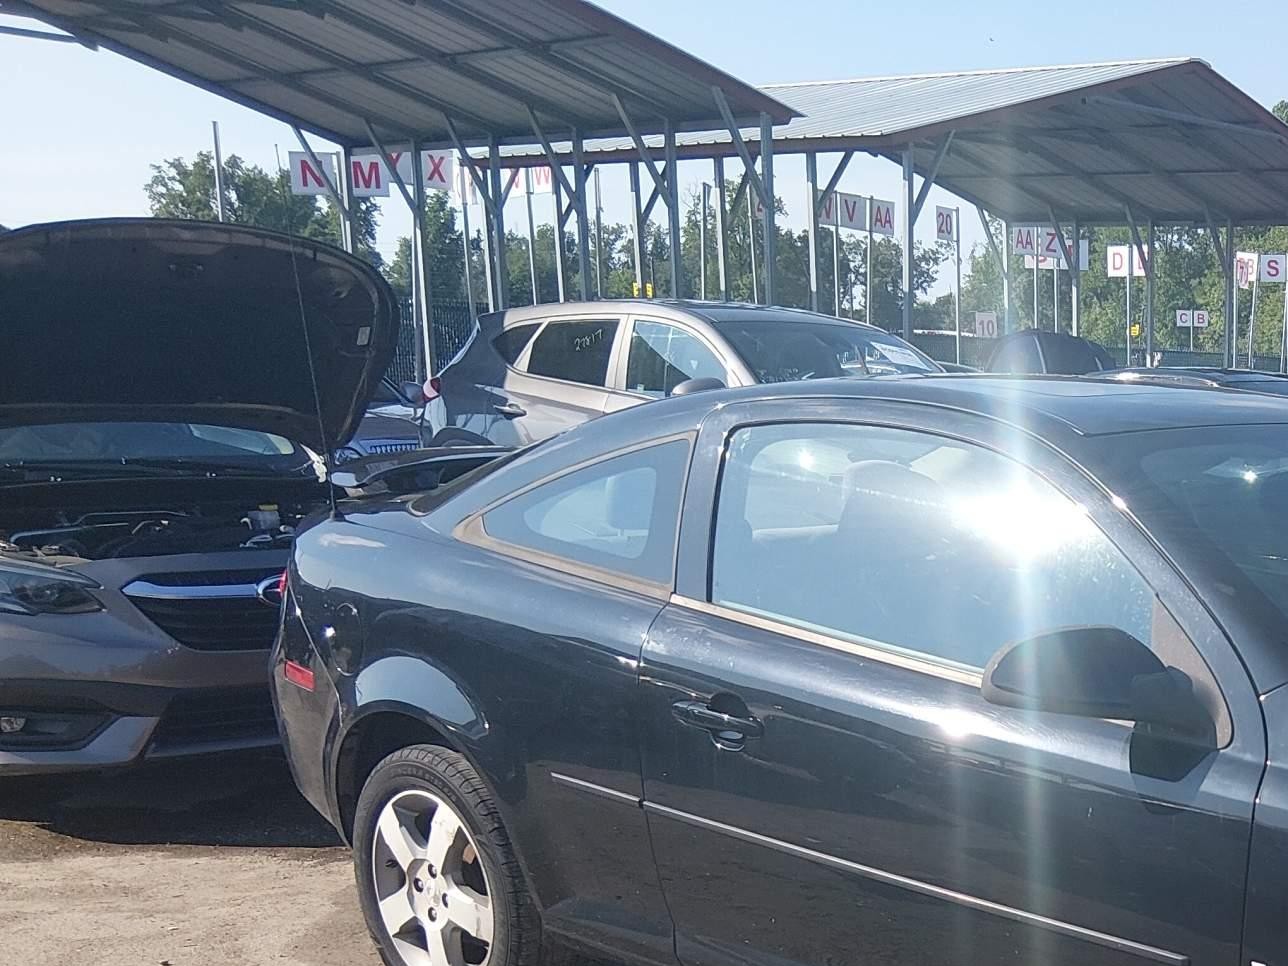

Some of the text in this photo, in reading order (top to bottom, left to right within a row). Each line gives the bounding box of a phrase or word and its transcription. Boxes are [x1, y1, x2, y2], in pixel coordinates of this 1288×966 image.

[300, 159, 325, 188] N
[354, 161, 381, 189] M
[427, 154, 446, 183] X
[845, 201, 856, 222] V
[874, 205, 892, 229] AA
[937, 212, 952, 234] 20
[1016, 229, 1033, 250] AA
[1045, 233, 1057, 253] Z
[1112, 252, 1123, 270] D
[1267, 259, 1280, 277] S
[978, 319, 995, 337] 10
[1179, 312, 1188, 324] C
[1197, 313, 1206, 324] B
